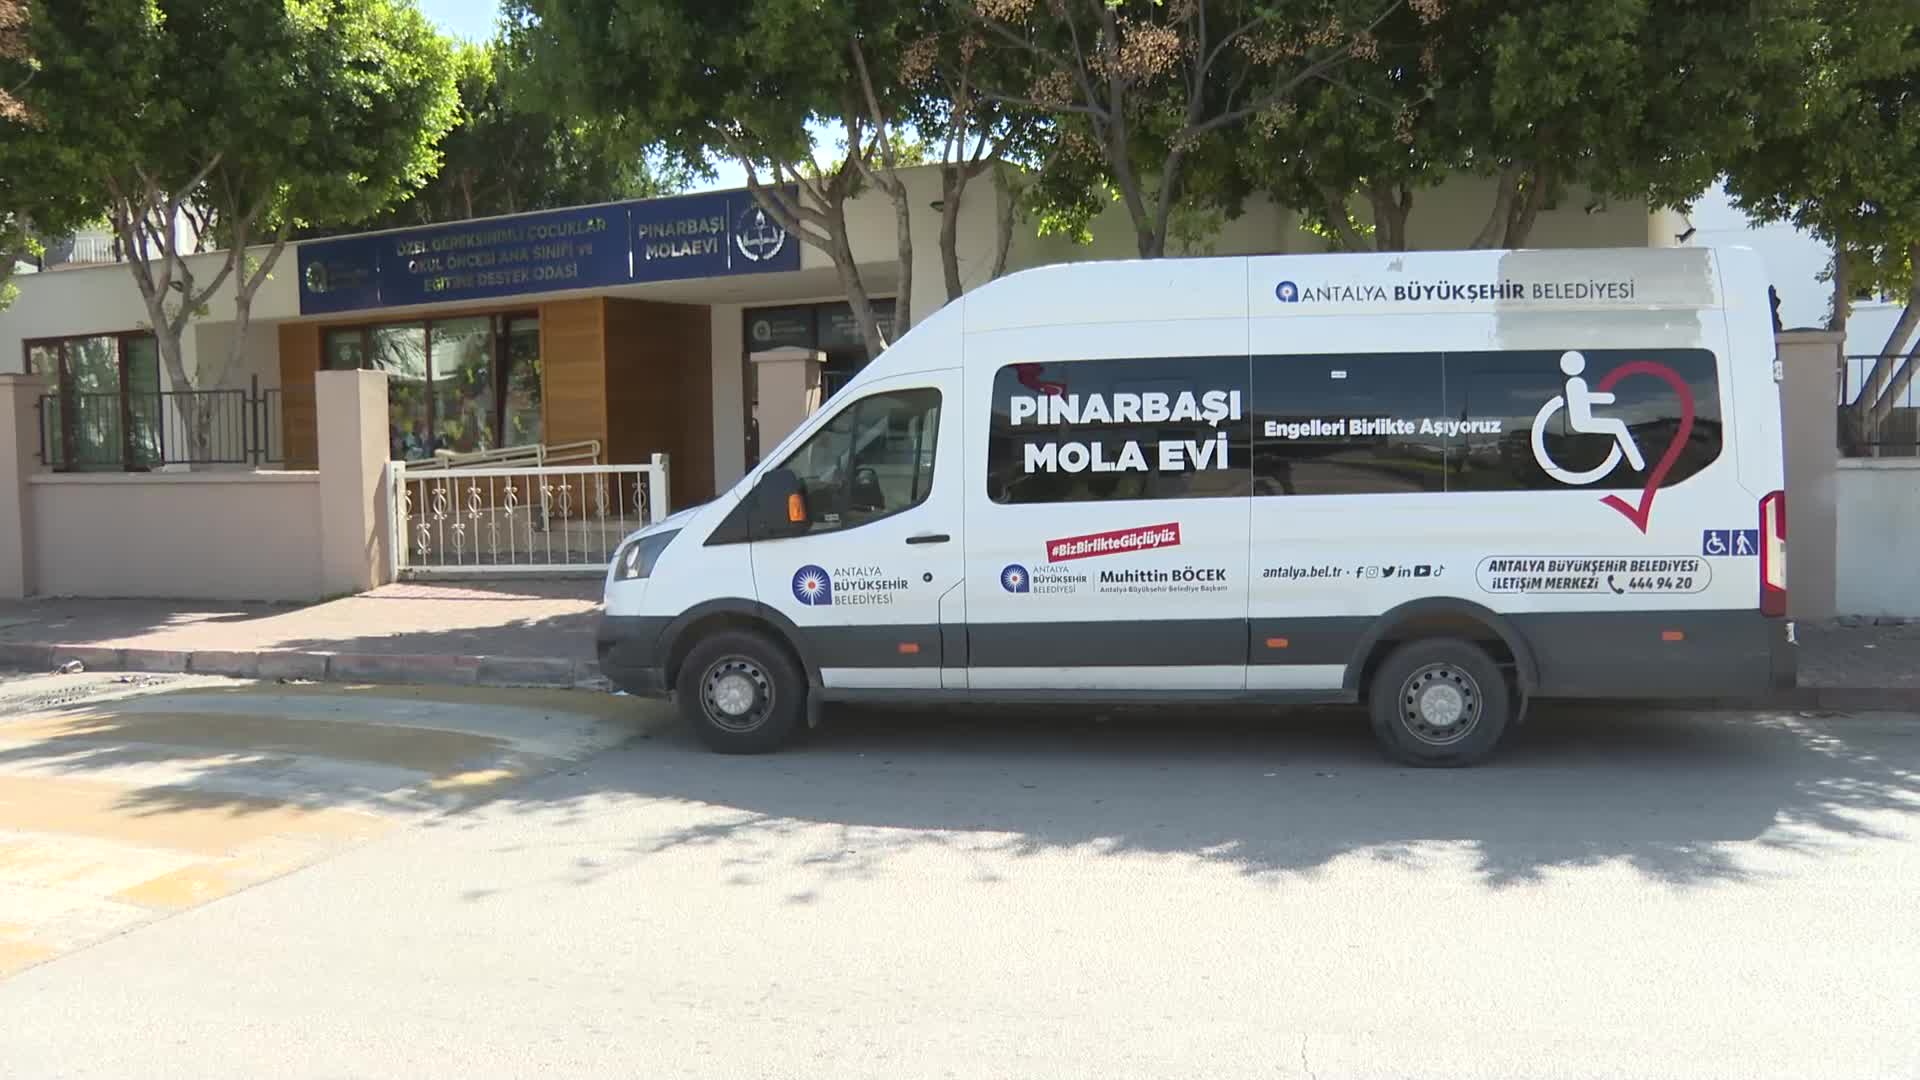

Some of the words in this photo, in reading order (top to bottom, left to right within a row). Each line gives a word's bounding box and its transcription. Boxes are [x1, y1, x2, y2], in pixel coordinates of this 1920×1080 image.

[639, 216, 725, 239] PINARBAŞI
[477, 269, 529, 287] DESTEK
[1302, 286, 1387, 302] ANTALYA
[1394, 281, 1525, 304] BÜYÜKŞEHİR
[1532, 280, 1635, 300] BELEDİYESİ
[1010, 390, 1242, 428] PINARBAŞI
[1264, 420, 1345, 440] Engelleri
[1349, 419, 1415, 436] Birlikte
[1419, 418, 1502, 438] Aşıyoruz
[1024, 441, 1148, 473] MOLA
[1159, 432, 1228, 471] EVİ
[1052, 529, 1176, 557] #BizBirlikteGüçlüyüz
[834, 566, 883, 577] ANTALYA
[1033, 565, 1070, 574] ANTALYA
[1100, 569, 1168, 583] Muhittin
[1172, 566, 1226, 581] BÖCEK
[1263, 565, 1342, 580] antalya.bel.tr
[1488, 559, 1545, 573] ANTALYA
[1548, 560, 1627, 576] BÜYÜKŞEHİR
[1630, 560, 1699, 572] BELEDİYESİ
[834, 577, 908, 592] BÜYÜKŞEHİR
[1033, 574, 1087, 585] BÜYÜKŞEHİR
[1544, 577, 1599, 590] MERKEZİ
[1628, 577, 1653, 589] 444
[1656, 577, 1673, 589] 94
[1675, 577, 1693, 589] 20
[1033, 585, 1076, 593] BELEDİYESİ
[834, 592, 893, 605] BELEDİYESİ
